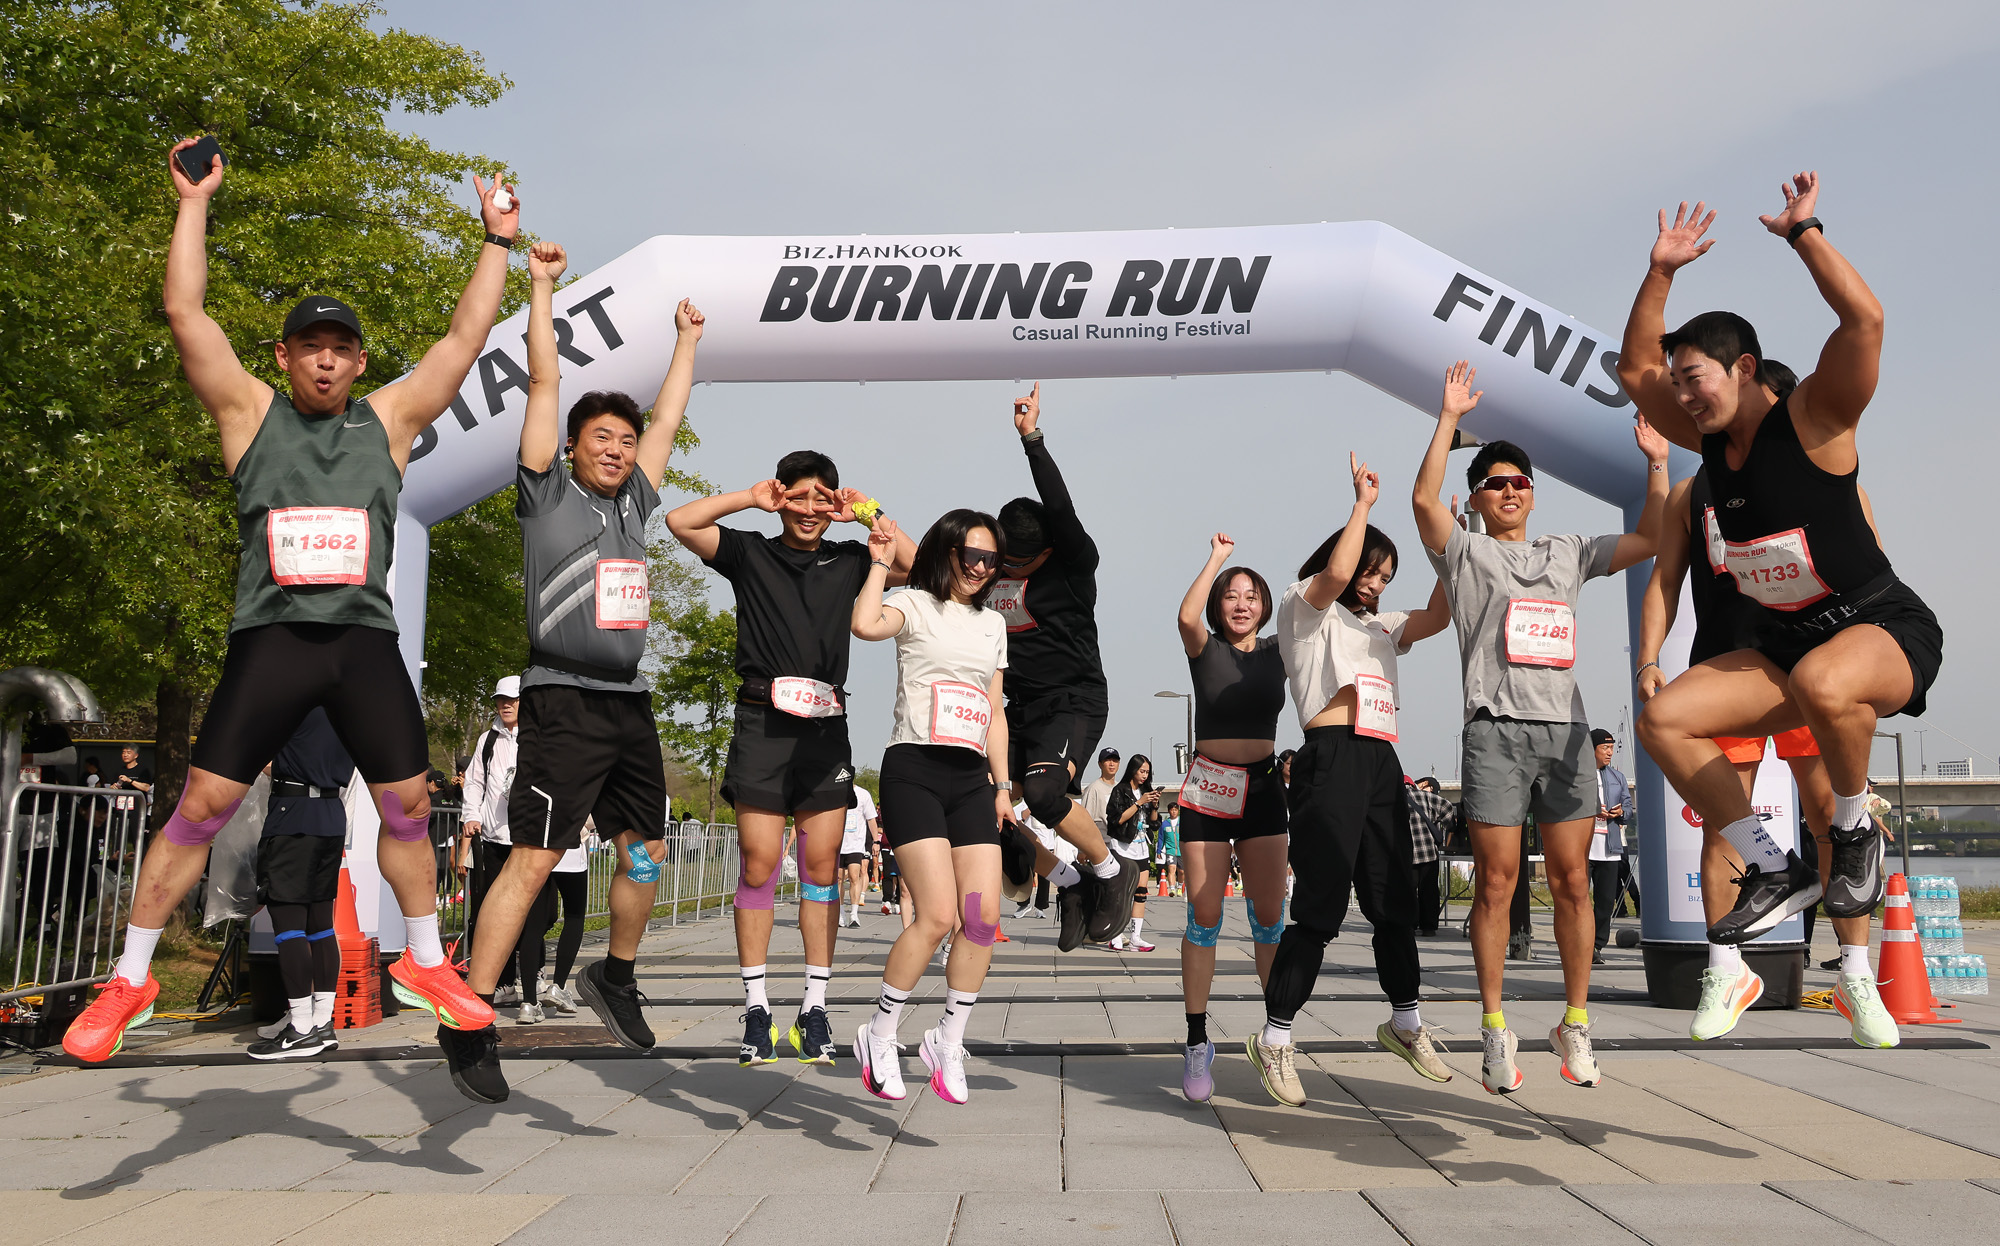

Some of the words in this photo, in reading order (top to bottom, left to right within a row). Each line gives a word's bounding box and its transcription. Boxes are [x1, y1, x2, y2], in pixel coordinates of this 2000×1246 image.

[759, 260, 1093, 323] BURNING
[1105, 256, 1273, 318] RUN
[1012, 324, 1079, 342] Casual
[1086, 322, 1169, 342] Running
[1175, 319, 1251, 338] Festival
[1433, 272, 1640, 420] FINIS
[278, 514, 313, 523] BURNING
[281, 536, 295, 548] M
[299, 534, 358, 550] 1362
[1751, 547, 1767, 556] RUN
[1775, 540, 1797, 550] 10km
[1738, 571, 1750, 580] M
[1750, 562, 1800, 584] 1733
[606, 587, 619, 597] M
[994, 598, 1018, 610] 1361
[1514, 604, 1543, 613] BURNING
[1514, 623, 1526, 633] M
[1527, 623, 1569, 640] 2185
[780, 689, 791, 698] M
[943, 704, 953, 714] W
[954, 705, 987, 726] 3240
[1364, 698, 1372, 707] M
[1373, 698, 1394, 716] 1356
[1191, 775, 1200, 785] W
[1199, 779, 1238, 798] 3239
